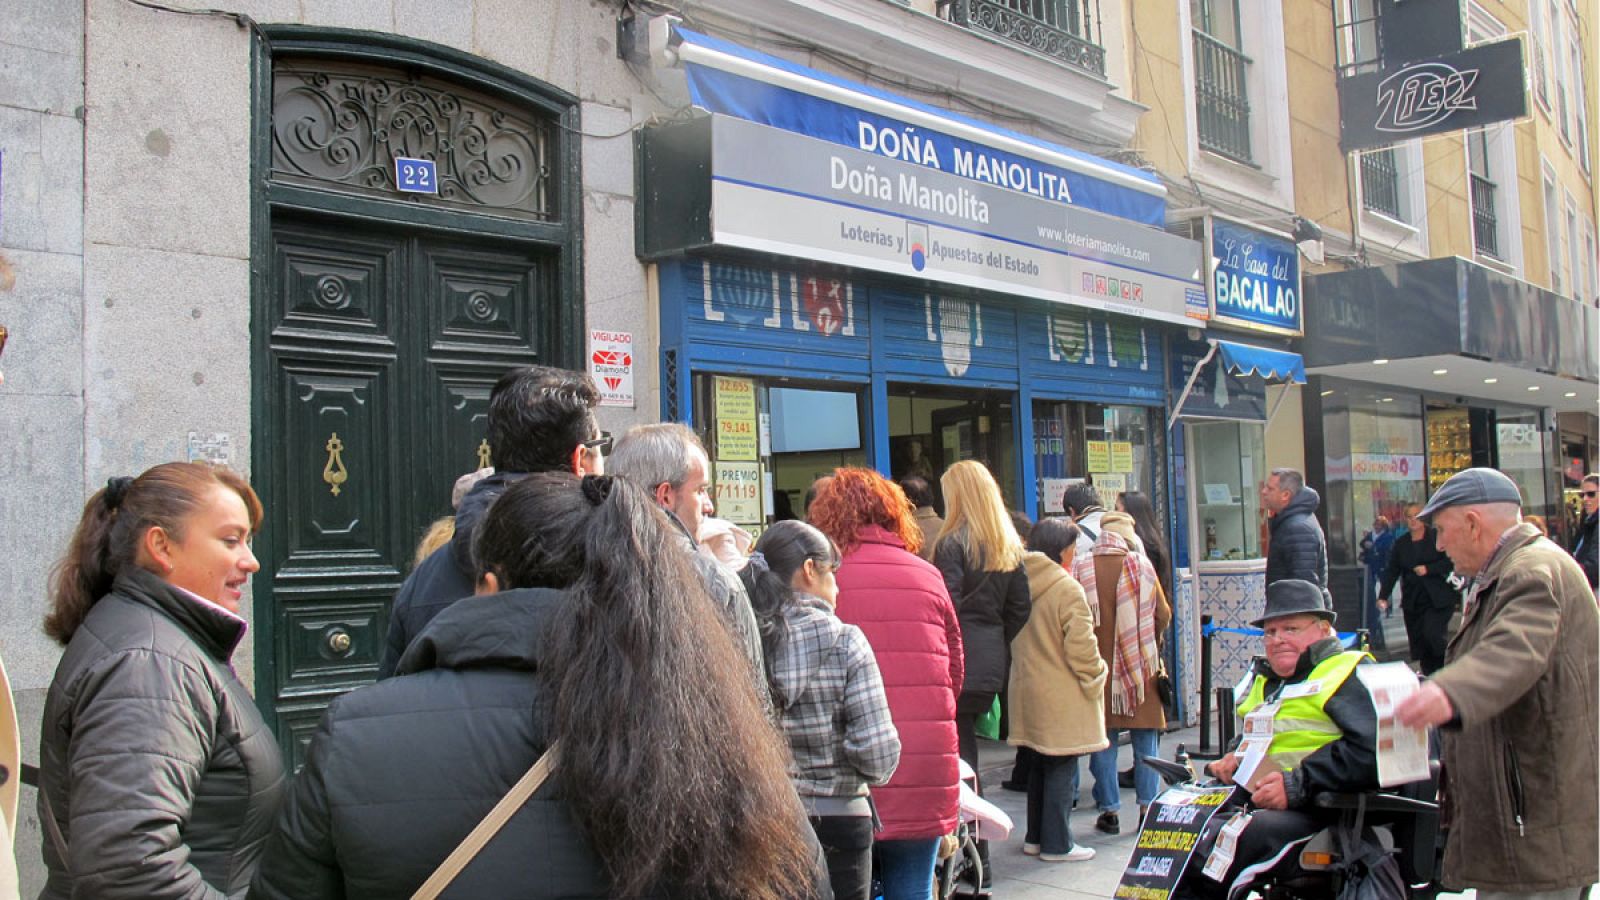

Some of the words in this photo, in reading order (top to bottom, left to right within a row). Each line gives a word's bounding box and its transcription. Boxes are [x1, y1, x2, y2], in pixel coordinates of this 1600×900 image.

[403, 164, 430, 187] 22
[858, 121, 941, 169] DOÑA
[953, 147, 1073, 204] MANOLITA
[830, 155, 893, 201] Doña
[898, 172, 990, 225] Manolita
[896, 237, 904, 253] y
[931, 239, 984, 265] Apuestas
[986, 251, 1002, 269] del
[1005, 255, 1040, 277] Estado
[1036, 224, 1151, 263] www.loteriamanolita.com
[1222, 238, 1240, 270] La
[1241, 242, 1269, 277] Casa
[1271, 255, 1289, 282] del
[1216, 269, 1297, 319] BACALAO
[592, 331, 632, 344] VIGILADO
[720, 421, 752, 433] 79.141
[715, 484, 756, 499] 71119
[722, 470, 758, 481] PREMIO
